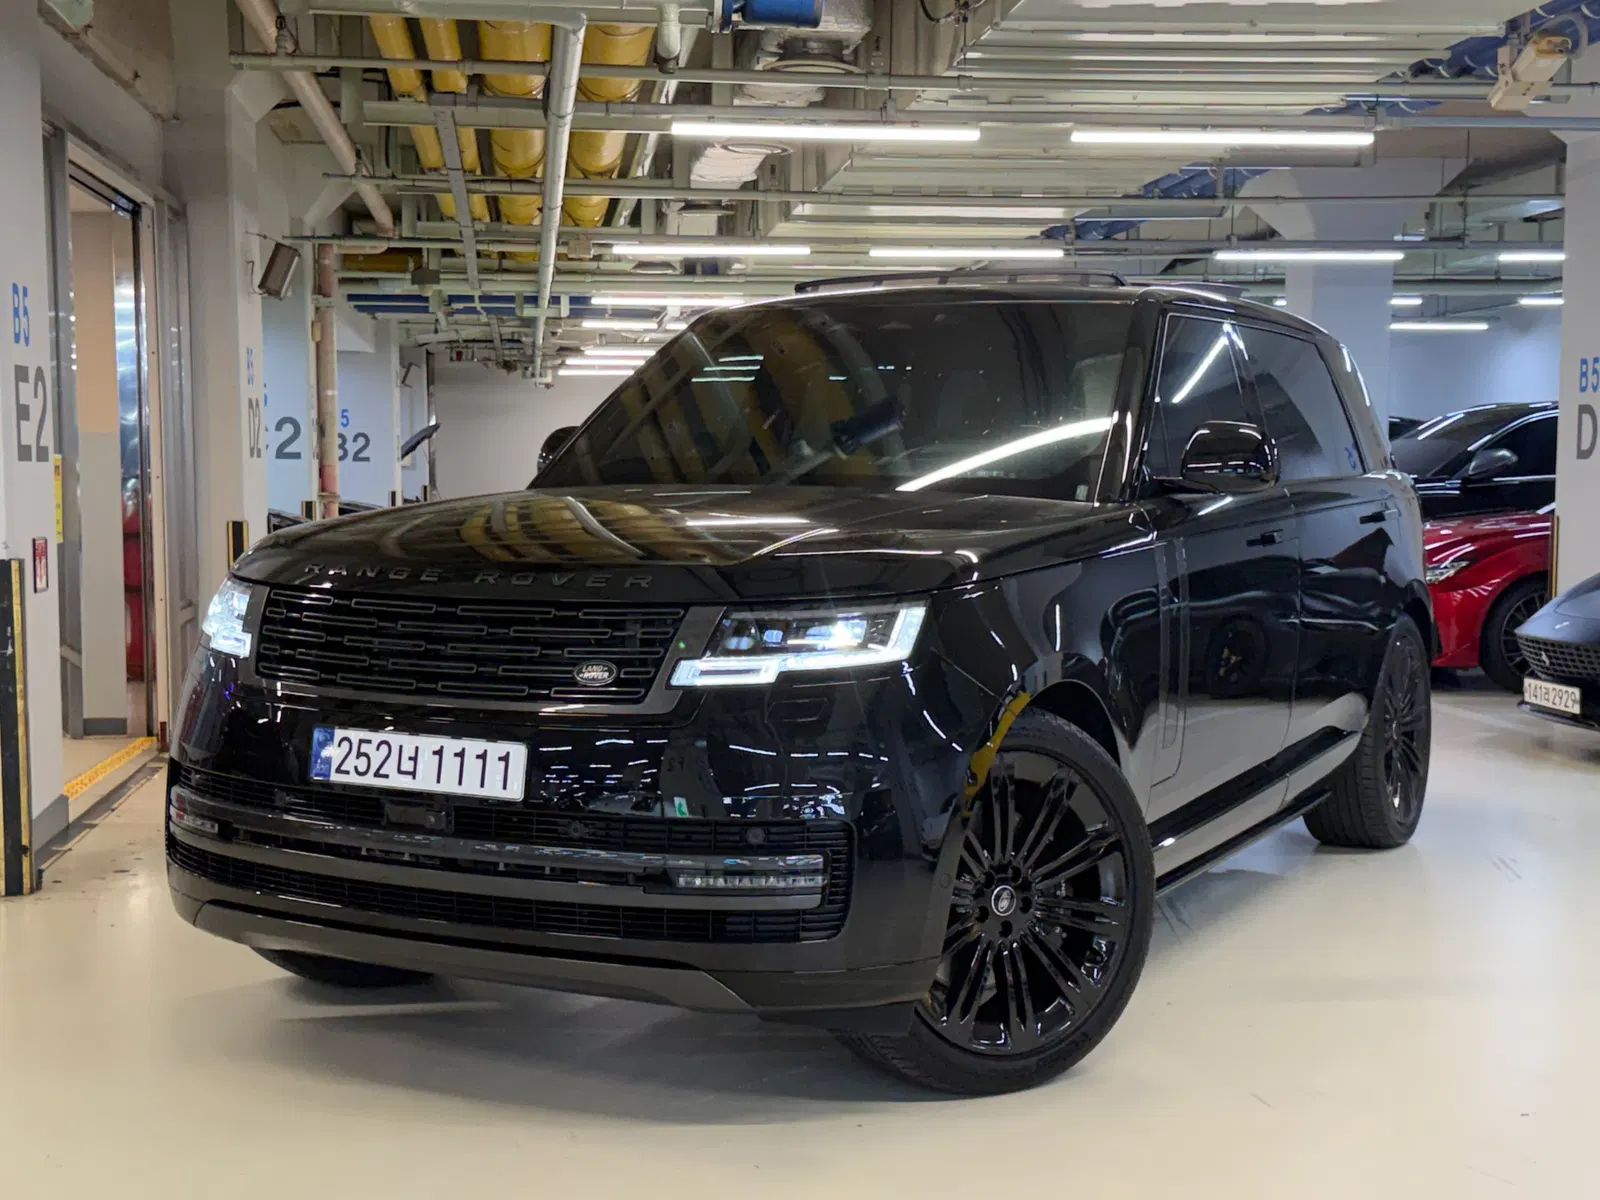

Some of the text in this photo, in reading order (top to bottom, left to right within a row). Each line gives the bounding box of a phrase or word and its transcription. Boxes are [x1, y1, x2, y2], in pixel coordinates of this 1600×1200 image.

[12, 282, 30, 347] B5
[1579, 356, 1600, 394] B5
[14, 364, 49, 462] E2
[248, 397, 262, 458] D2
[265, 416, 302, 459] 2
[1576, 404, 1598, 460] D
[304, 563, 654, 589] RANGE ROVER
[334, 736, 511, 791] 252너 1111
